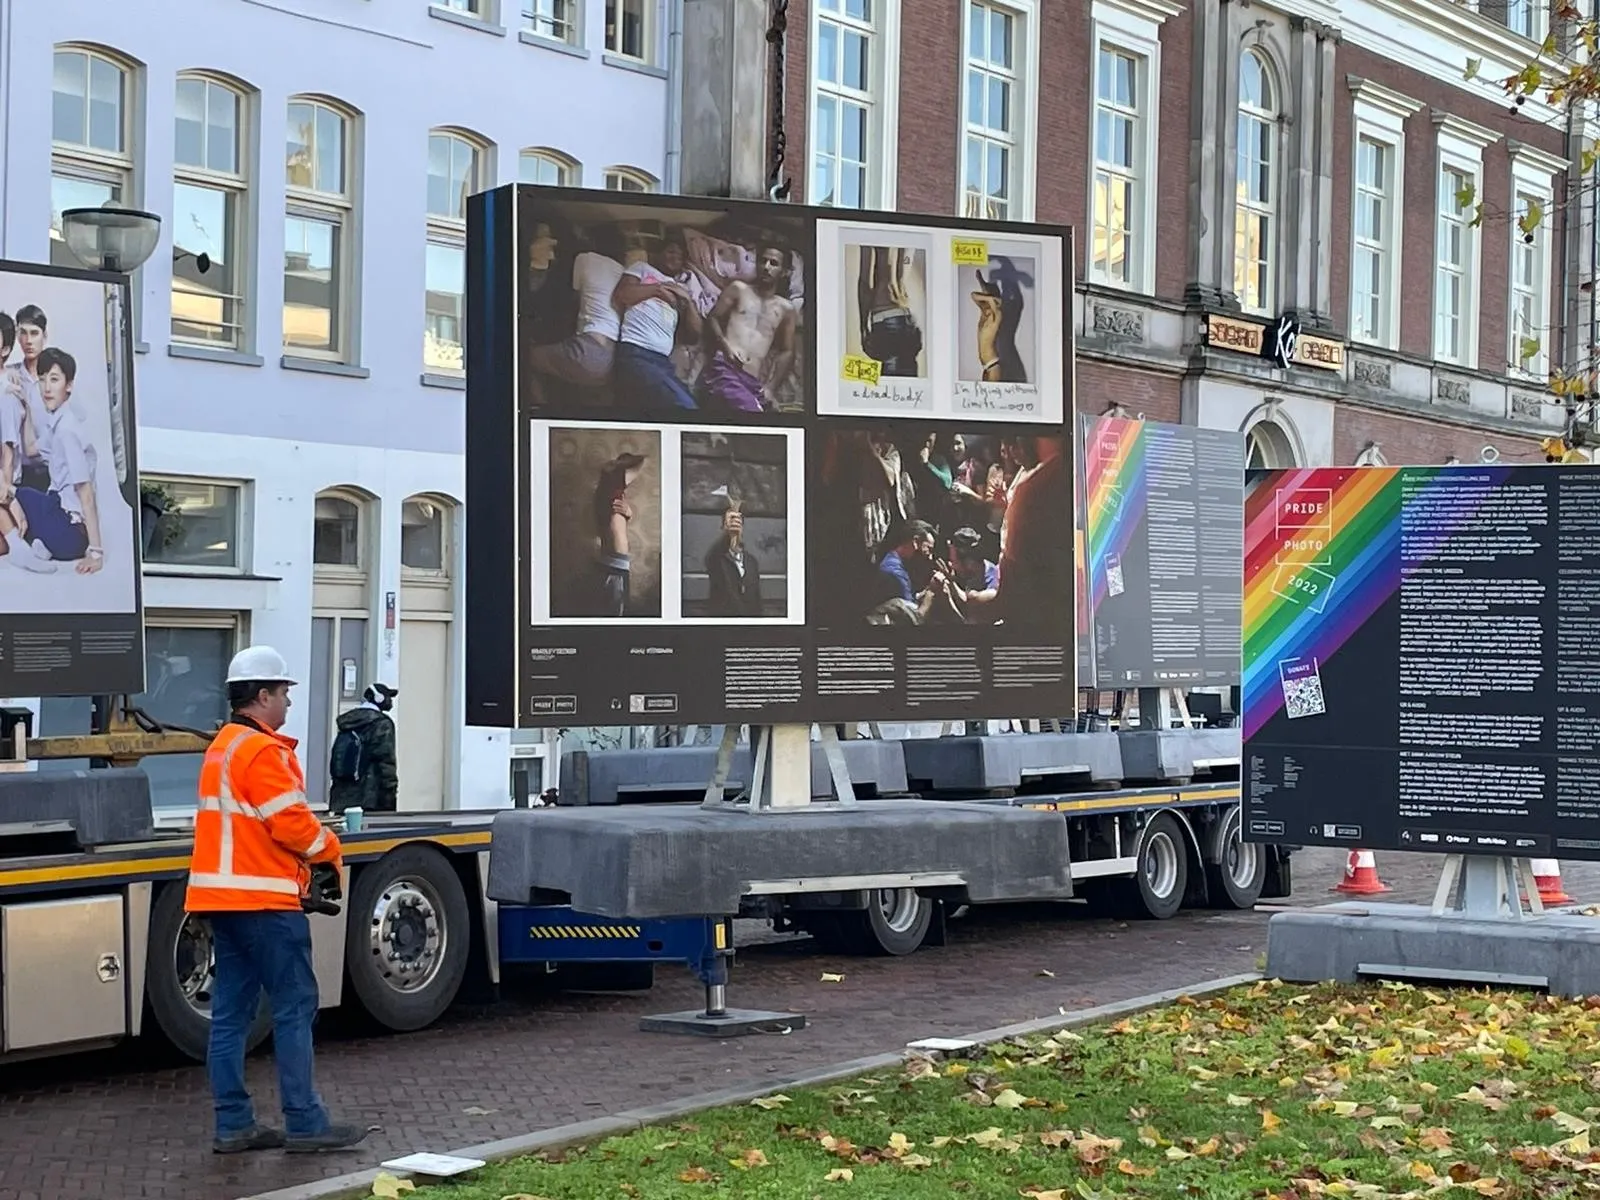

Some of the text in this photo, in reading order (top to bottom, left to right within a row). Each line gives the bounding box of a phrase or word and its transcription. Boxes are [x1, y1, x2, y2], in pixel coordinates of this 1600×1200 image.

[974, 381, 1002, 399] flying
[1285, 503, 1323, 514] PRIDE
[1284, 540, 1323, 551] PHOTO
[1288, 575, 1318, 595] 2022
